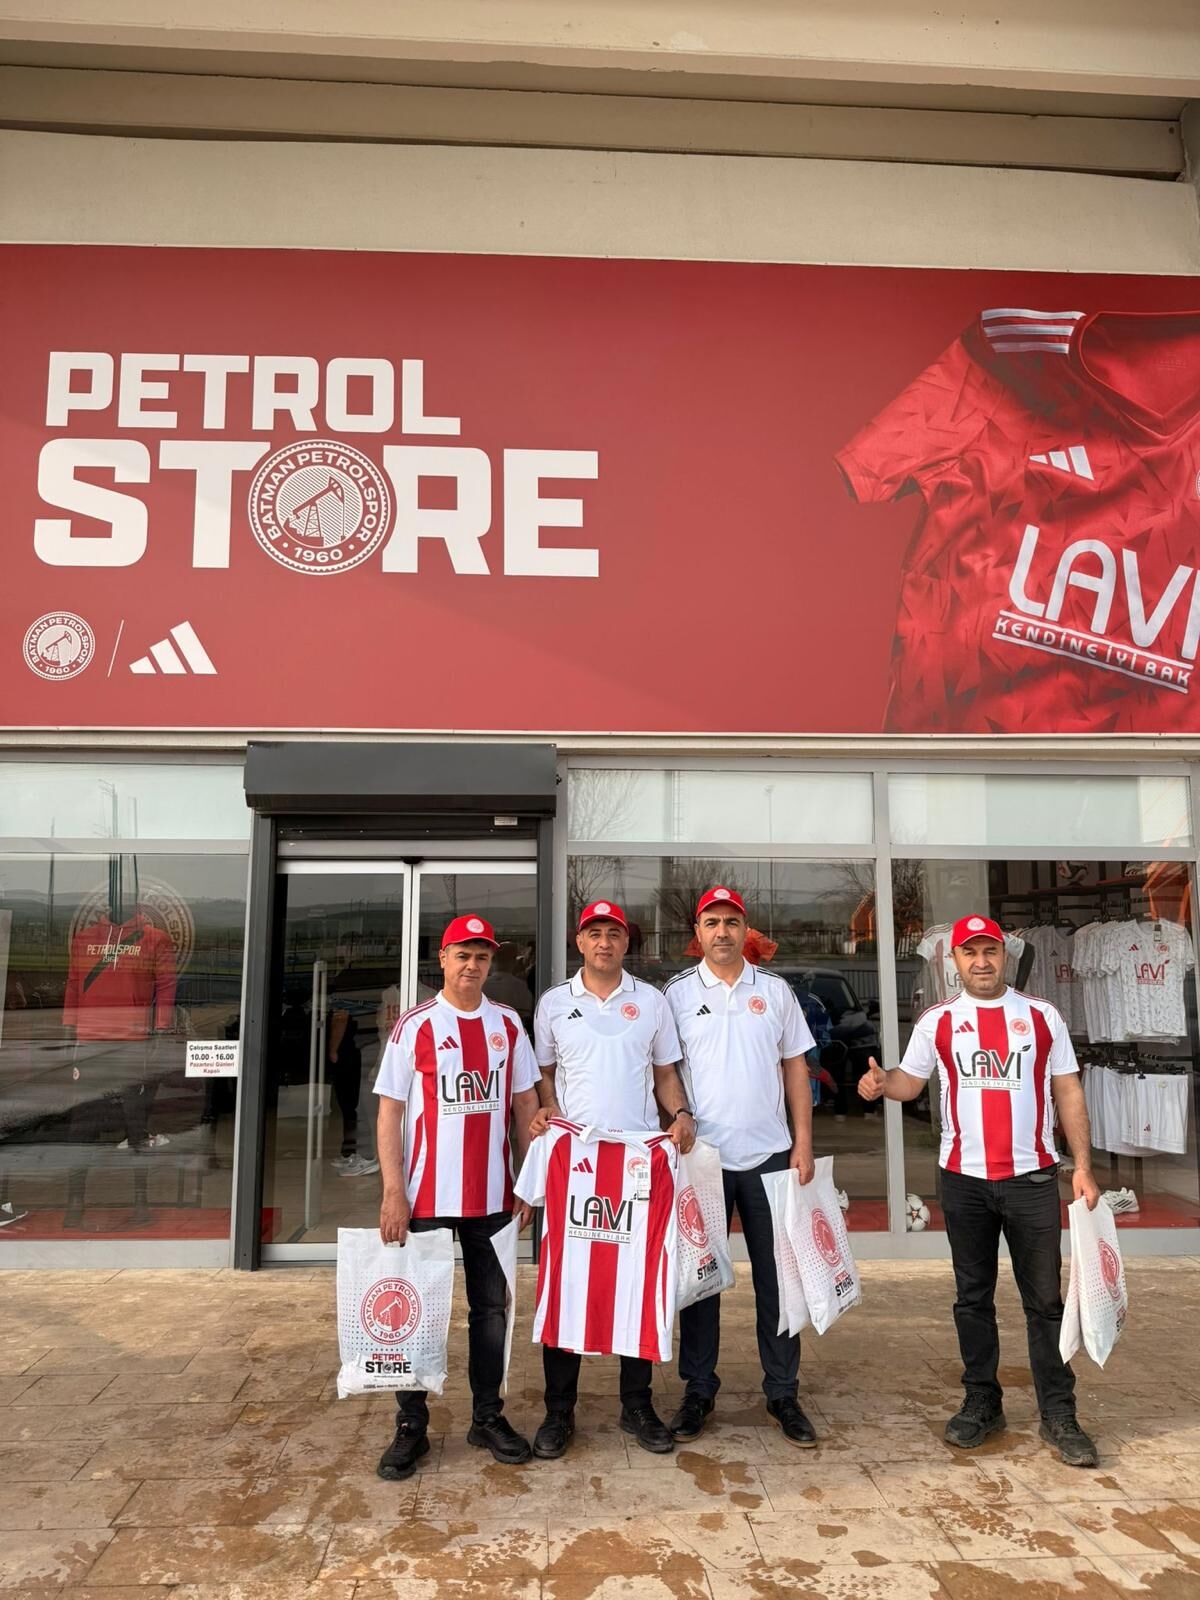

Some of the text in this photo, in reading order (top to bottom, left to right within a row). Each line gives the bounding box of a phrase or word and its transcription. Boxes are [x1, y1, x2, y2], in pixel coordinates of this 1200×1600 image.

[45, 351, 460, 436] PETROL
[33, 438, 599, 577] STORE
[260, 451, 379, 542] BATMAN PETROLSPOR
[294, 547, 343, 562] 1960
[29, 617, 89, 664] BATMAN PETROLSPOR
[45, 666, 70, 674] 1960
[1144, 661, 1191, 687] BAK
[366, 1282, 417, 1328] BATMAN PETROLSPOR
[379, 1331, 401, 1339] 1960
[372, 1353, 406, 1361] PETROL
